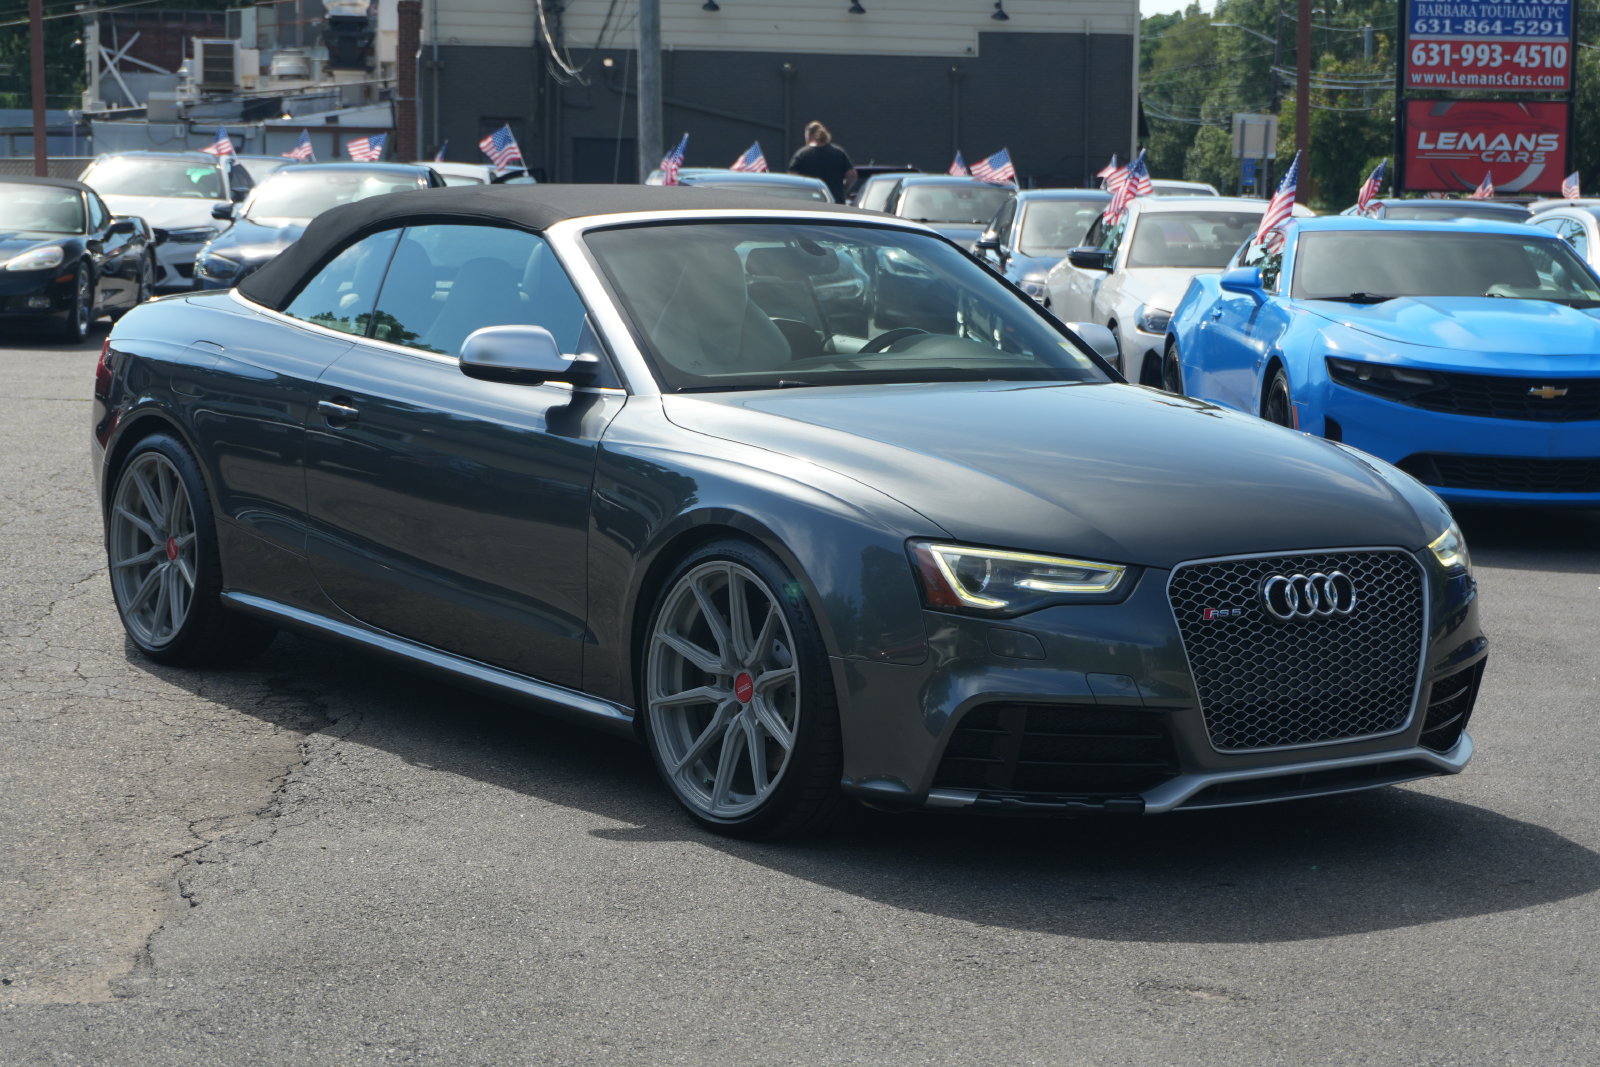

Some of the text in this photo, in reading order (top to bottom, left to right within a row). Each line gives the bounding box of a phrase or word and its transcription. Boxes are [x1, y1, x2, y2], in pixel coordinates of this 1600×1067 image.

[1417, 4, 1564, 19] BARBARA TOUHAMY PC
[1414, 18, 1565, 35] 631-864-5291
[1411, 43, 1567, 68] 631-993-4510
[1411, 71, 1564, 86] www.LemansCars.com
[1417, 132, 1559, 152] LEMANS
[1481, 151, 1546, 163] CARS
